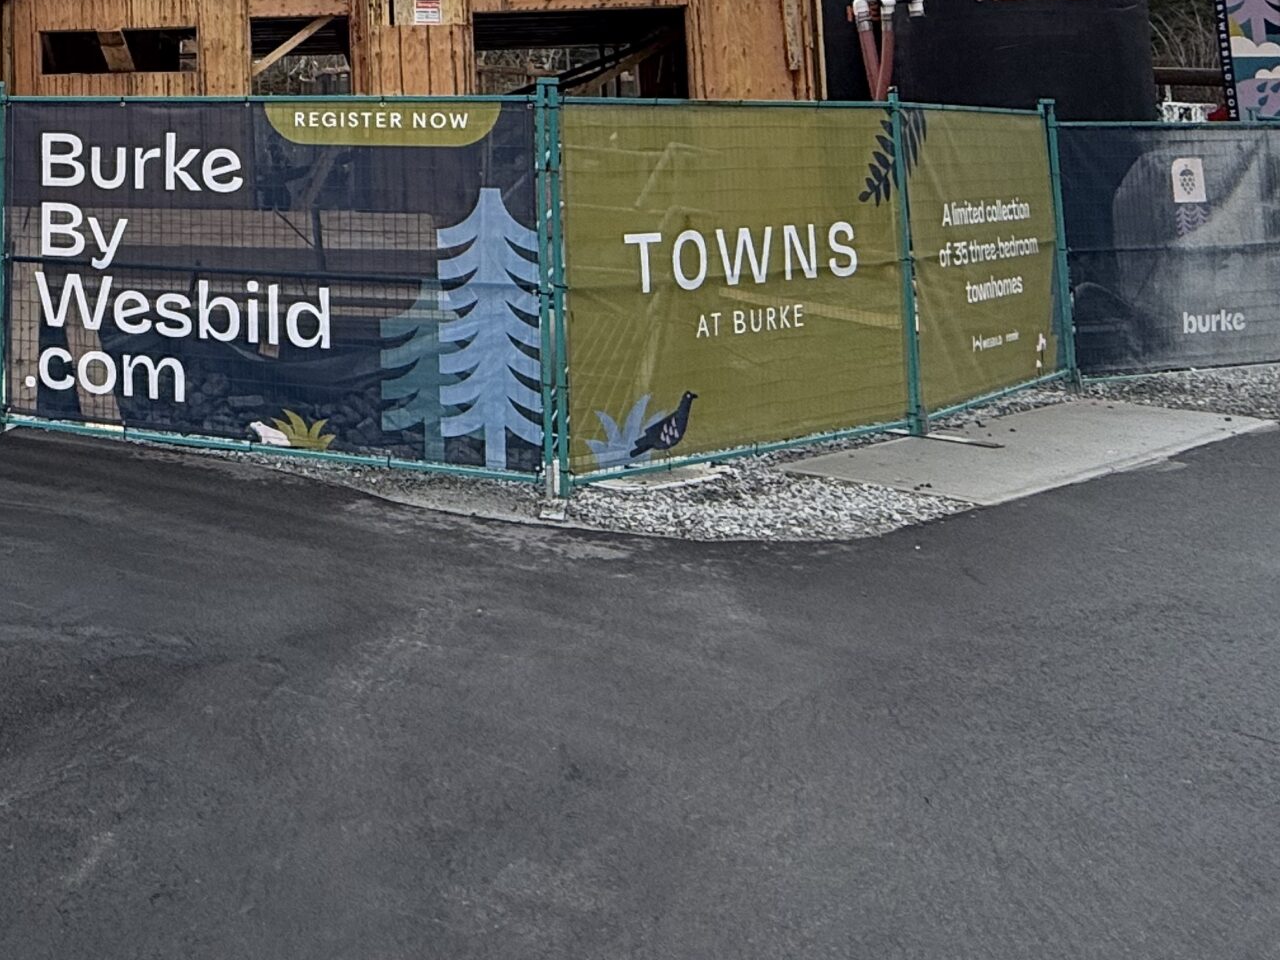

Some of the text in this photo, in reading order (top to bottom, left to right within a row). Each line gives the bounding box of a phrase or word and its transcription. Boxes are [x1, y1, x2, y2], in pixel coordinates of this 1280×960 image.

[294, 111, 469, 129] REGISTER NOW
[40, 131, 244, 193] Burke
[941, 197, 1031, 227] A limited collection
[40, 201, 129, 270] By
[939, 235, 1040, 267] of 35 three-bedroom
[623, 221, 859, 294] TOWNS
[965, 275, 1024, 303] townhomes
[34, 271, 331, 350] Wesbild
[696, 304, 805, 338] AT BURKE
[1182, 309, 1247, 334] burke
[24, 343, 187, 403] .com
